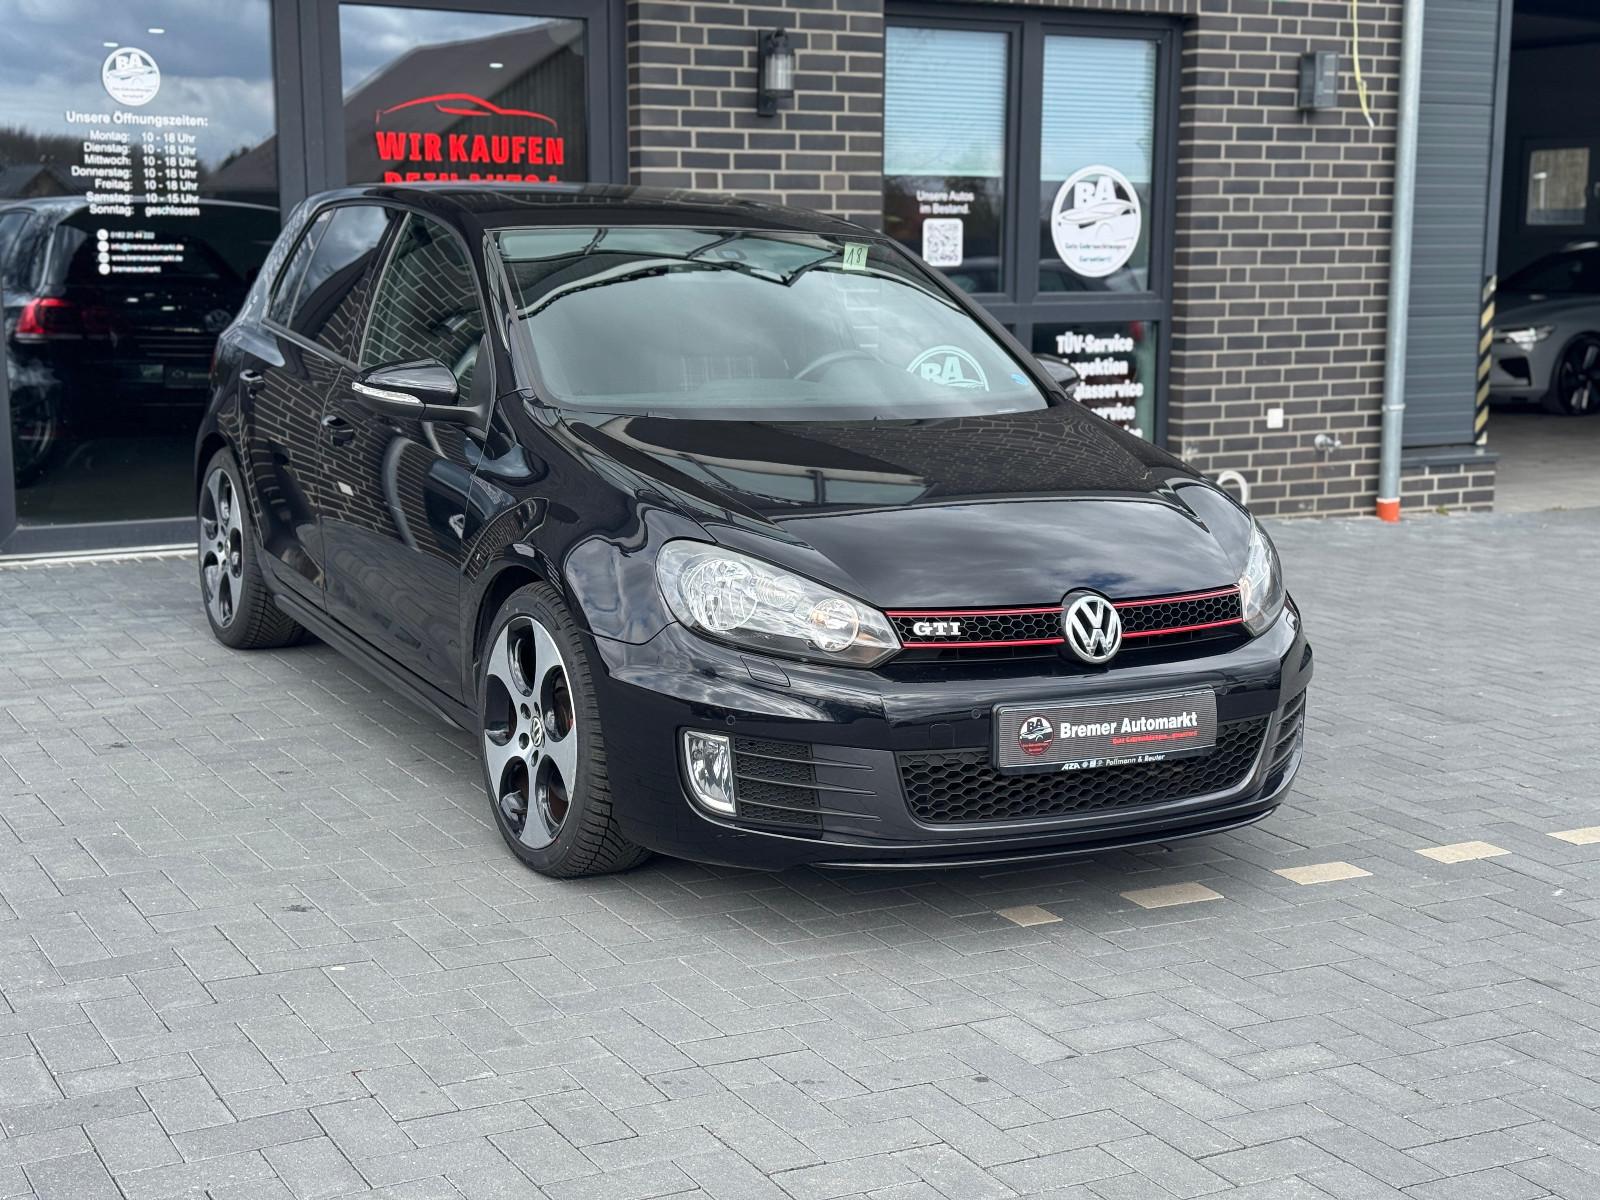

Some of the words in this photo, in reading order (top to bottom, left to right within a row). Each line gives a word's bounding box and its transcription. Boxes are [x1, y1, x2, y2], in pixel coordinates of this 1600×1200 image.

[115, 53, 144, 70] BA
[66, 111, 110, 124] Unsere
[113, 111, 209, 127] Öffnungszeiten:
[90, 130, 130, 143] Montag:
[142, 132, 154, 143] 10
[164, 133, 176, 143] 18
[177, 133, 196, 144] Uhr
[84, 142, 131, 155] Dienstag:
[142, 144, 155, 154] 10
[164, 145, 176, 155] 18
[178, 145, 196, 155] Uhr
[376, 131, 442, 161] WIR
[448, 134, 565, 165] KAUFEN
[84, 154, 132, 165] Mittwoch:
[143, 156, 155, 166] 10
[165, 157, 177, 167] 18
[179, 157, 197, 167] Uhr
[71, 166, 132, 180] Donnerstag:
[143, 168, 156, 178] 10
[165, 168, 177, 179] 18
[179, 169, 198, 179] Uhr
[94, 178, 133, 192] Freitag:
[144, 180, 157, 190] 10
[166, 180, 178, 191] 18
[180, 181, 198, 191] Uhr
[1074, 175, 1116, 209] BA
[86, 191, 134, 205] Samstag:
[145, 193, 158, 203] 10
[167, 193, 179, 204] 15
[181, 194, 200, 204] Uhr
[916, 190, 948, 202] Unsere
[949, 190, 975, 202] Autos
[89, 203, 134, 217] Sonntag:
[145, 204, 200, 217] geschlossen
[919, 203, 932, 214] im
[847, 248, 863, 266] 18
[1055, 330, 1134, 354] TÜV-Service
[913, 621, 962, 636] GTI
[1027, 718, 1044, 732] BA
[1060, 721, 1117, 738] Bremer
[1121, 712, 1198, 734] Automarkt
[1061, 762, 1081, 771] AZA
[1106, 757, 1136, 767] Pollmann
